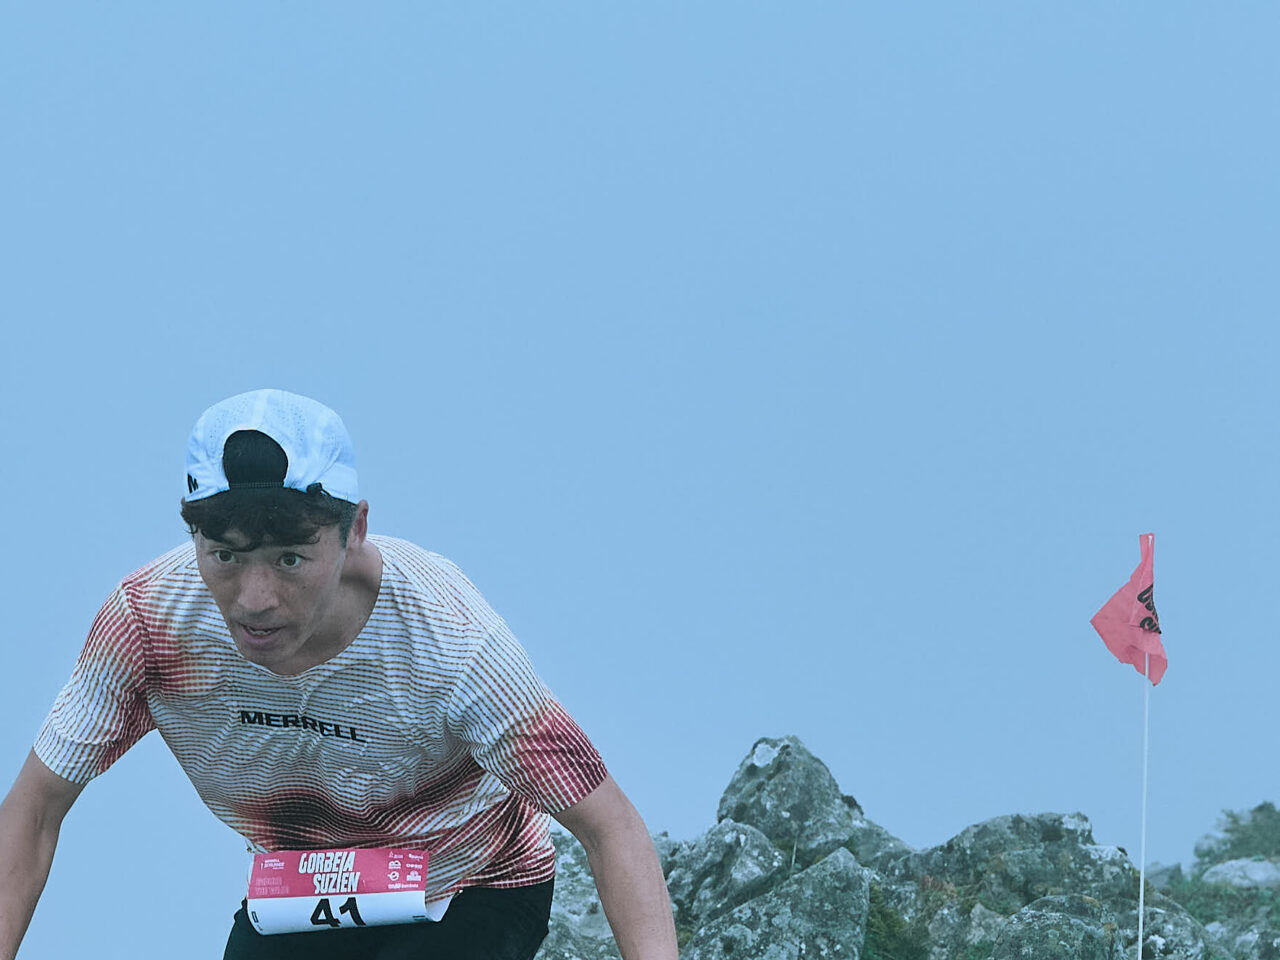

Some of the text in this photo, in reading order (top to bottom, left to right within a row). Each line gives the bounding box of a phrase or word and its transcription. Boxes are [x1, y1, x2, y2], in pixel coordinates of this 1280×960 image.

[240, 710, 368, 742] MERRELL
[298, 851, 355, 874] GORBEIA
[313, 871, 361, 895] SUZIEN
[310, 896, 367, 928] 41
